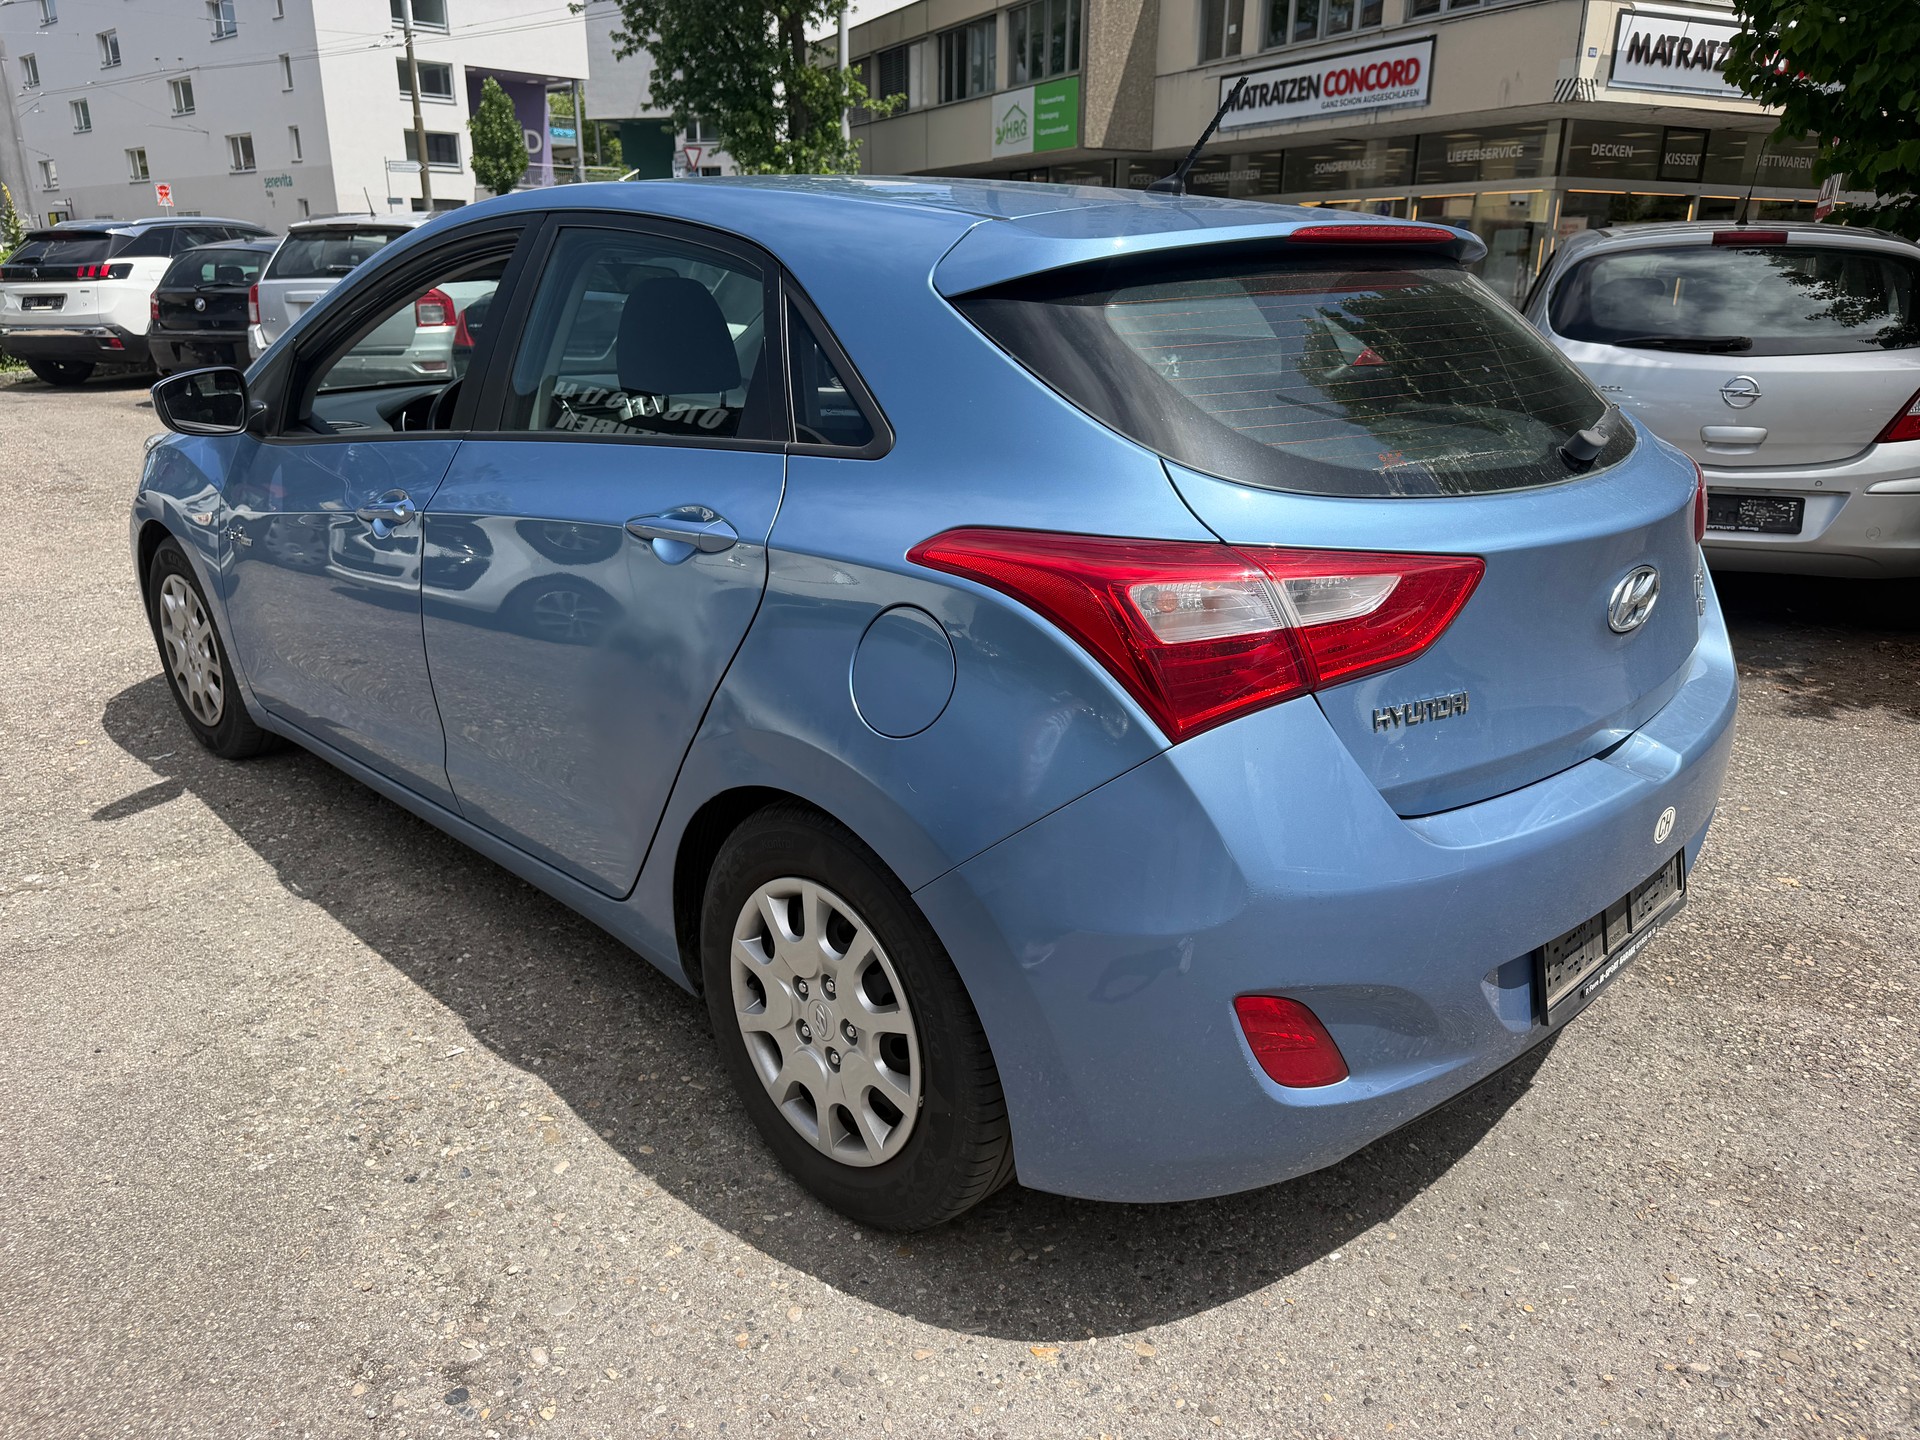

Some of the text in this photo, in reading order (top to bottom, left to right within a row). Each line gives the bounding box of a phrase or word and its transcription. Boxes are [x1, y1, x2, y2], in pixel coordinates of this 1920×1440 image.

[1626, 31, 1733, 72] MATRATZ
[1323, 57, 1421, 98] CONCORD
[1321, 99, 1340, 110] GANZ
[1363, 88, 1420, 105] AUSGESCHLAFEN
[1006, 118, 1028, 140] HRG
[1447, 145, 1524, 163] LIEFERSERVICE
[1591, 143, 1634, 158] DECKEN
[1664, 152, 1700, 166] KISSEN
[1314, 158, 1377, 175] SONDERMASSE
[264, 173, 293, 188] senevita
[1193, 169, 1262, 185] KINDERMATRATZEN
[1372, 690, 1469, 733] HYUNDAI
